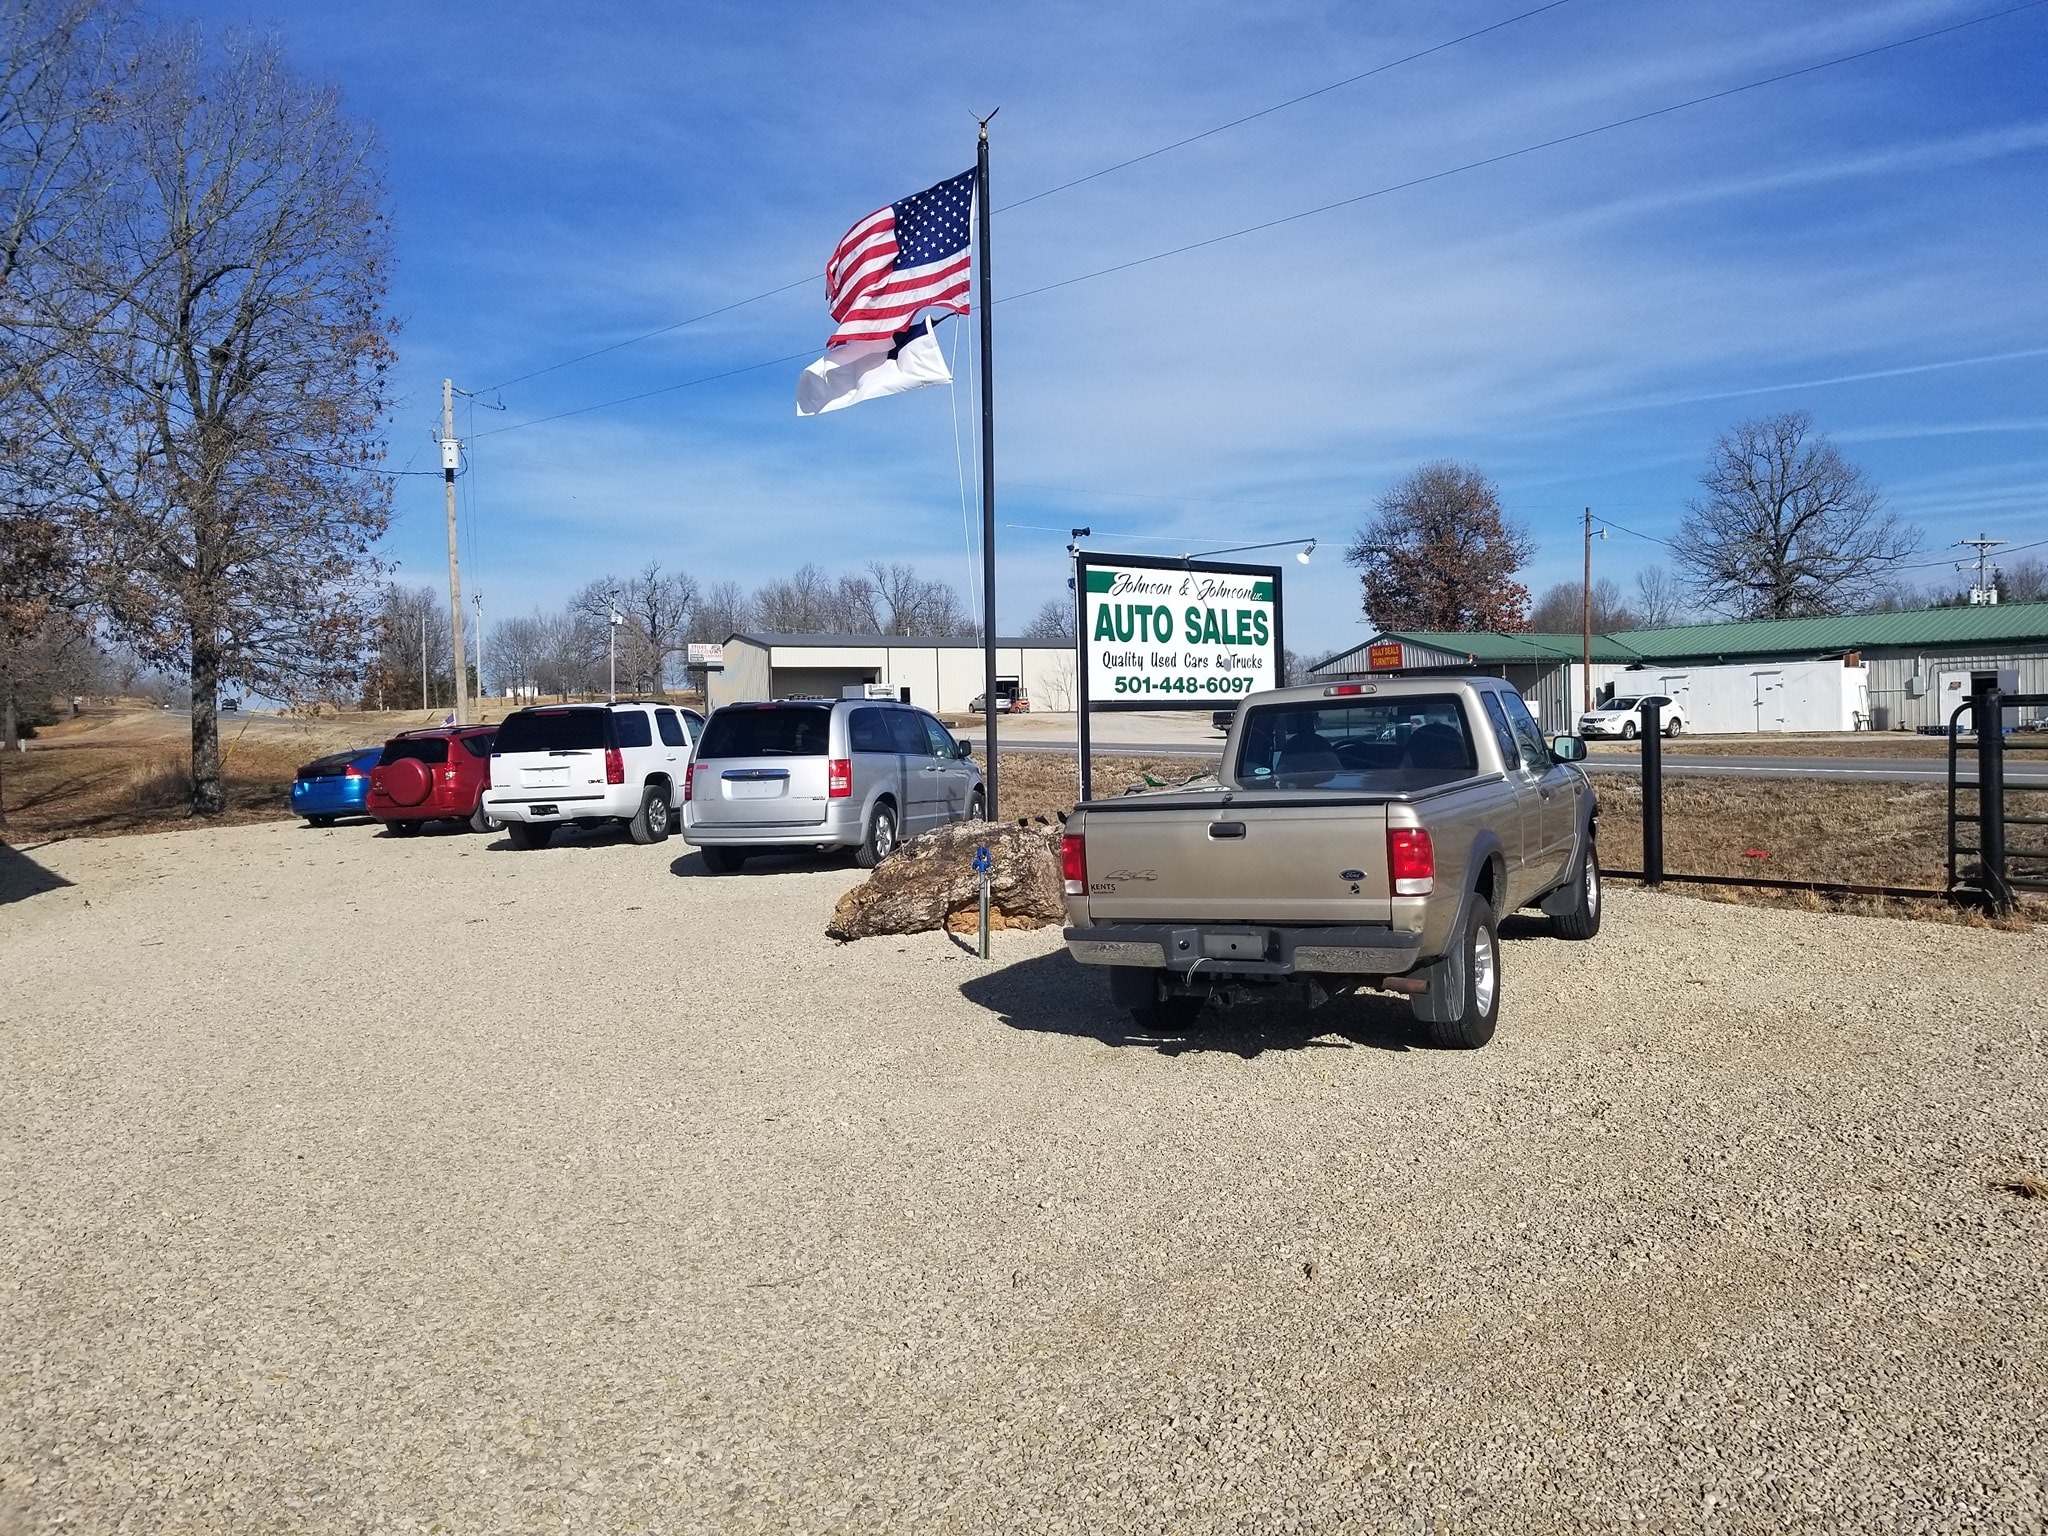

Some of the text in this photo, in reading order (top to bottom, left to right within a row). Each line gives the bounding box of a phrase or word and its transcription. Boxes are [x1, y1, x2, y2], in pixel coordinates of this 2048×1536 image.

[1112, 573, 1172, 596] Johnson
[1179, 578, 1189, 596] &
[1197, 578, 1251, 600] Johnson
[1094, 603, 1269, 646] AUTO SALES
[1103, 651, 1262, 671] Quality Used Cars & Trucks
[1373, 656, 1399, 666] FURNITURE
[1114, 677, 1254, 694] 501-448-6097
[1091, 883, 1115, 891] KENTS
